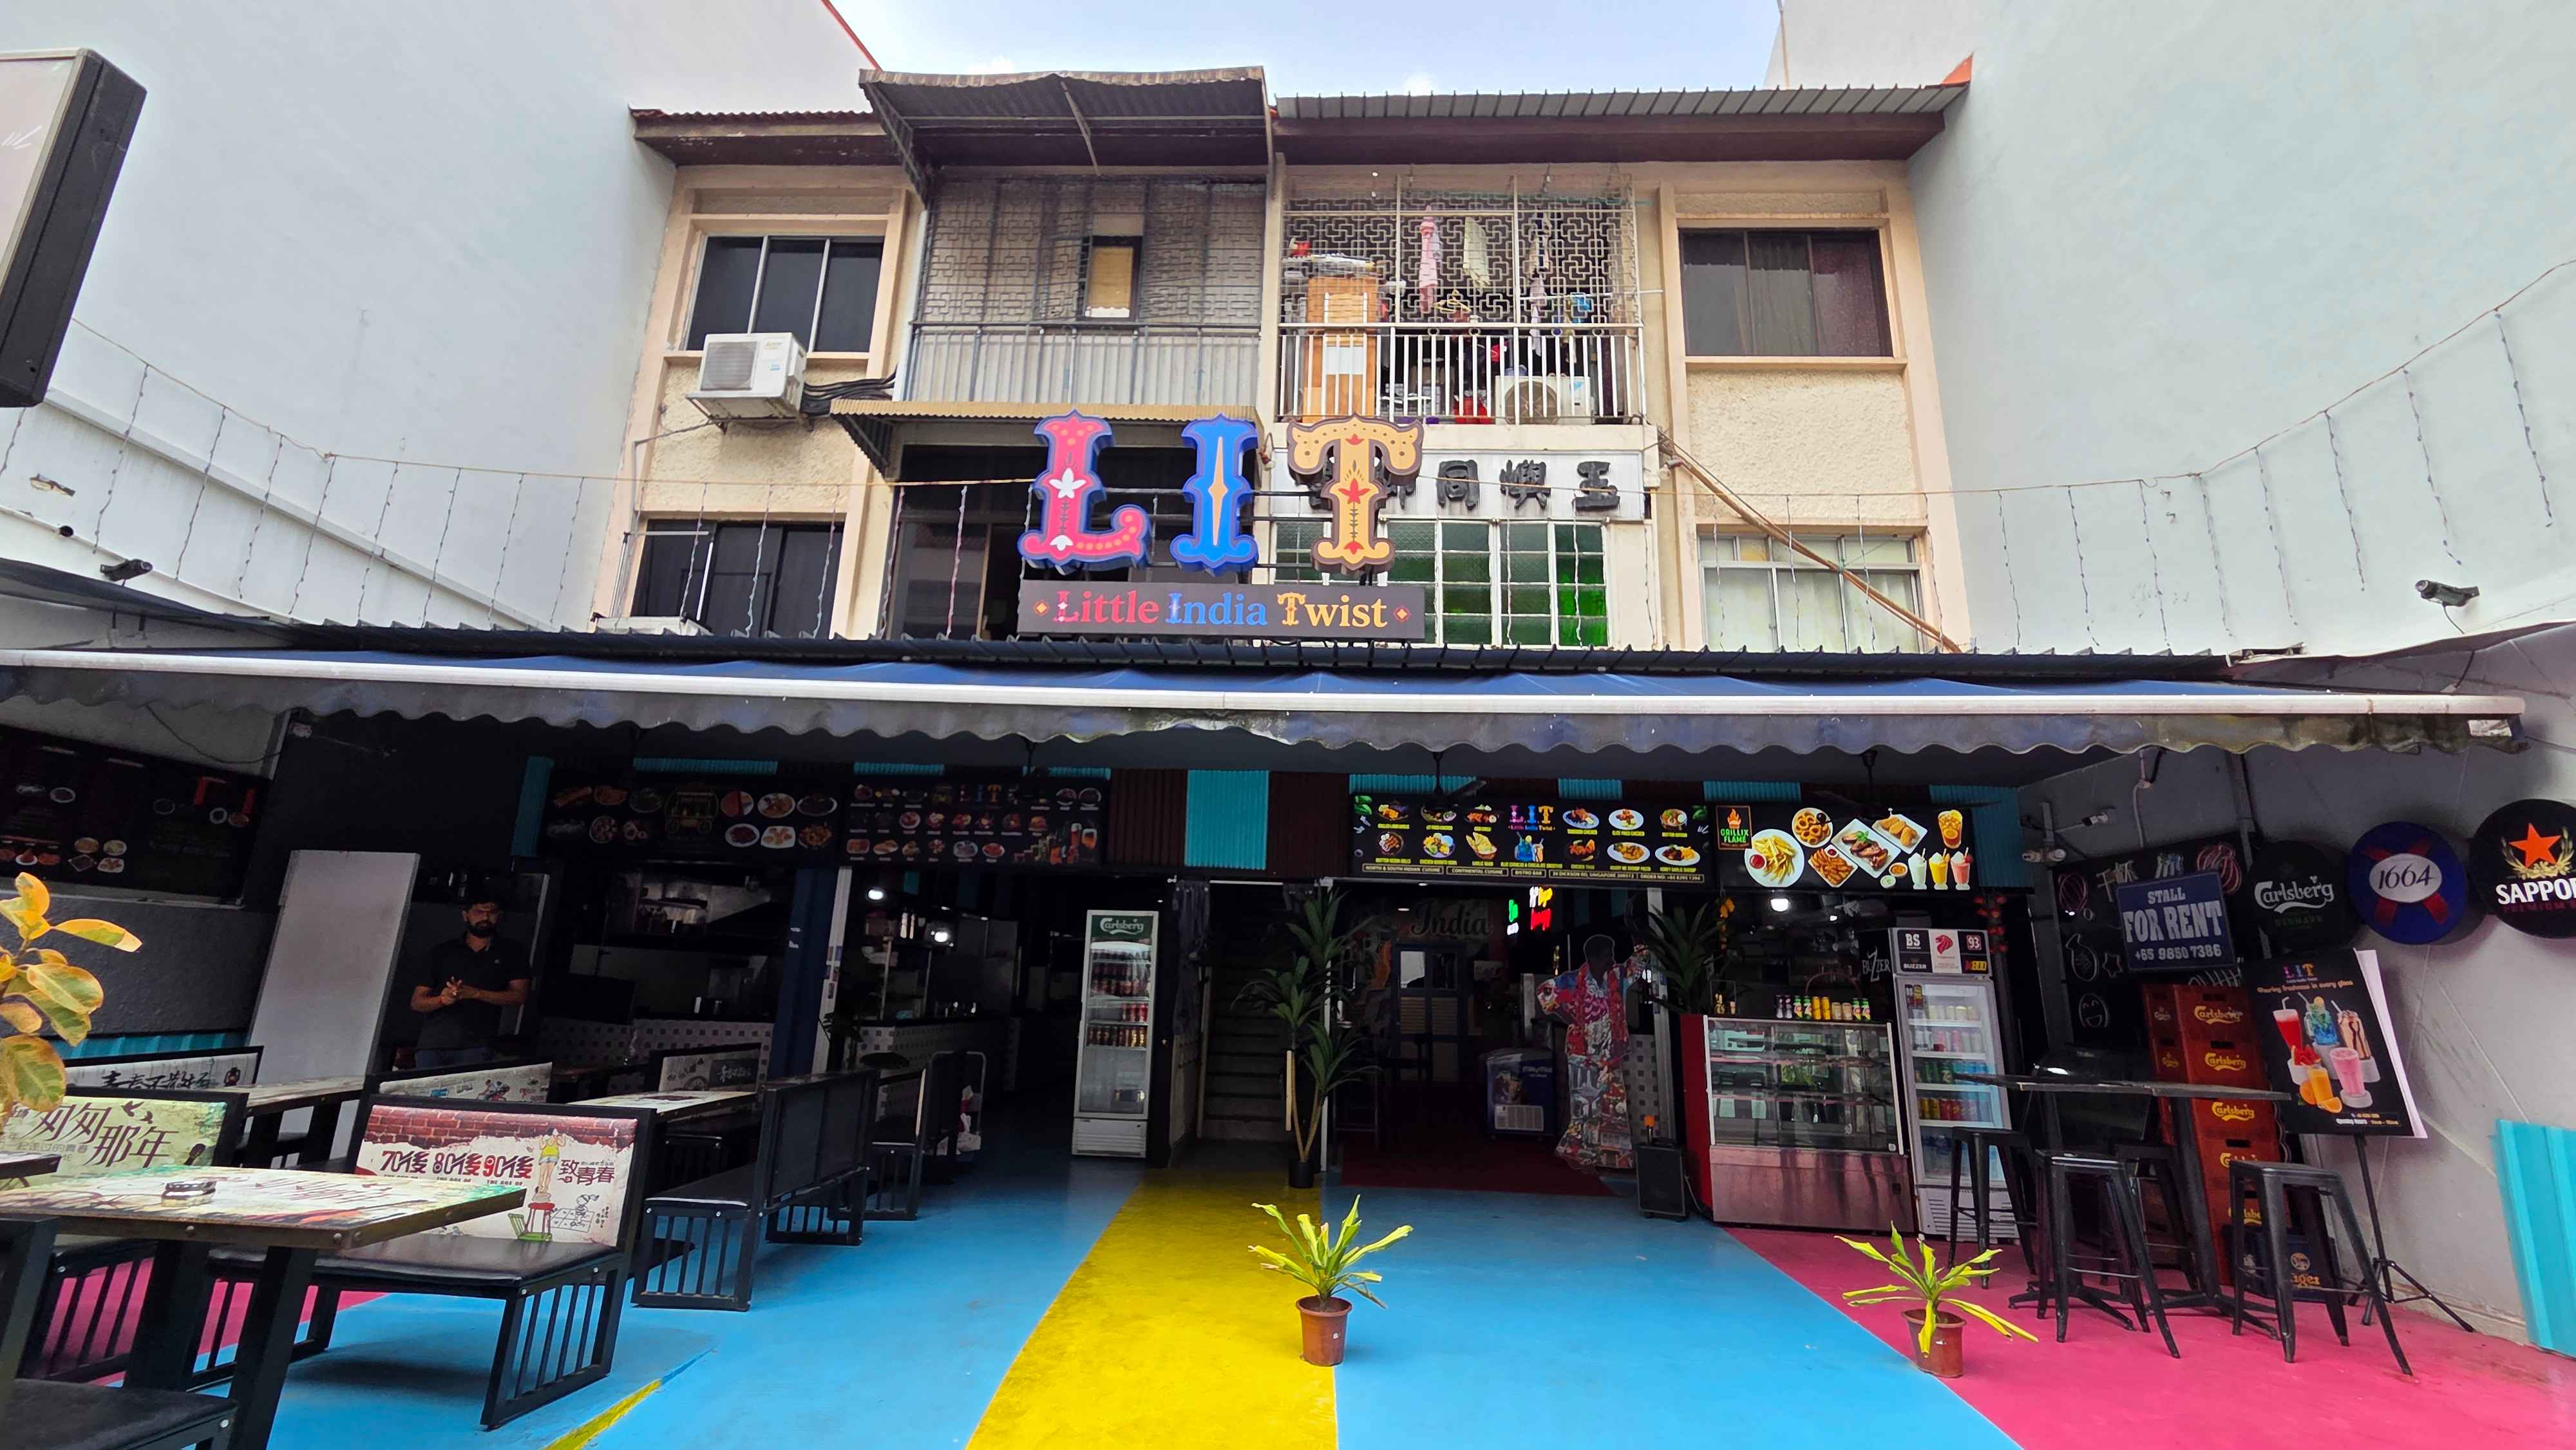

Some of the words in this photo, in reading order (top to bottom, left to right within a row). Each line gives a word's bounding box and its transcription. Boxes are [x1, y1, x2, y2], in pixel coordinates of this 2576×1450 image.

[1018, 410, 1425, 575] LIT
[1055, 591, 1159, 623] Little
[1165, 593, 1267, 626] India
[1276, 592, 1388, 629] Twist
[1509, 805, 1553, 824] LIT
[2378, 863, 2435, 890] 1664
[2147, 887, 2186, 904] STALL
[2254, 876, 2334, 914] Carlsberg
[1100, 918, 1144, 934] Carlsberg
[1410, 901, 1490, 937] India
[2123, 909, 2164, 943] FOR
[2163, 900, 2222, 940] RENT
[1905, 933, 1921, 946] BS
[1968, 936, 1980, 948] 93
[2135, 948, 2154, 961] +65
[2158, 946, 2189, 960] 9850
[2190, 944, 2222, 957] 7386
[2283, 963, 2314, 979] LIT
[2194, 1006, 2244, 1024] Carlsberg
[2205, 1053, 2246, 1071] Carlsberg
[2211, 1102, 2255, 1121] Carlsberg
